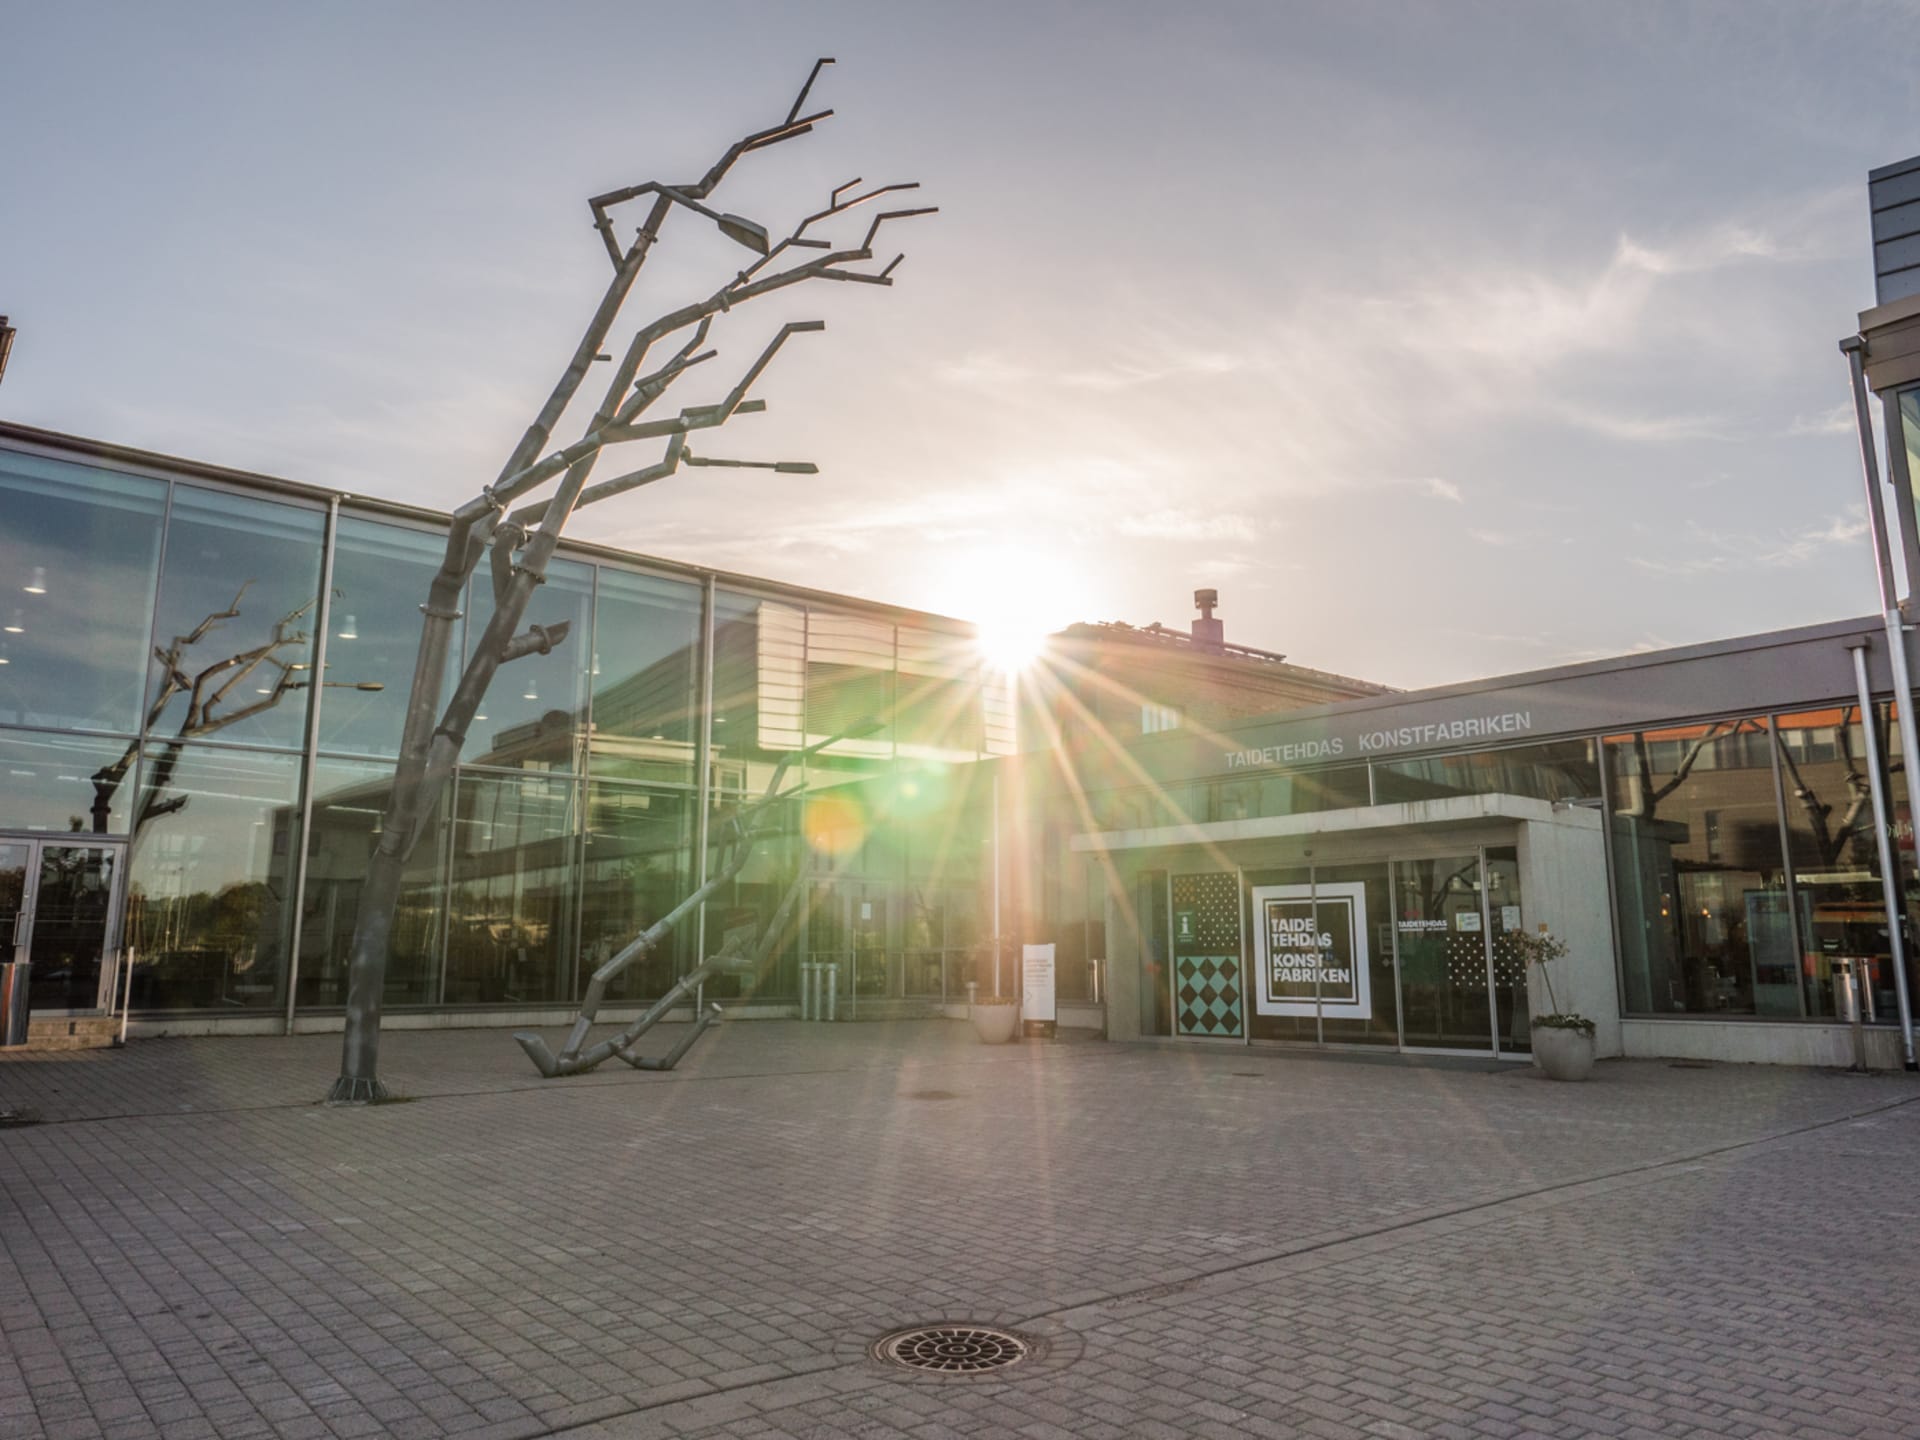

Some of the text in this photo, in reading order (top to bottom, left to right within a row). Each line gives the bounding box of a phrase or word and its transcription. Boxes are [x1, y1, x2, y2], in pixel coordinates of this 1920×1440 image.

[1225, 711, 1532, 769] TAIDETEHDAS KONSTFABRIKEN
[1271, 918, 1315, 932] TAIDE
[1273, 968, 1350, 983] FABRIKEN
